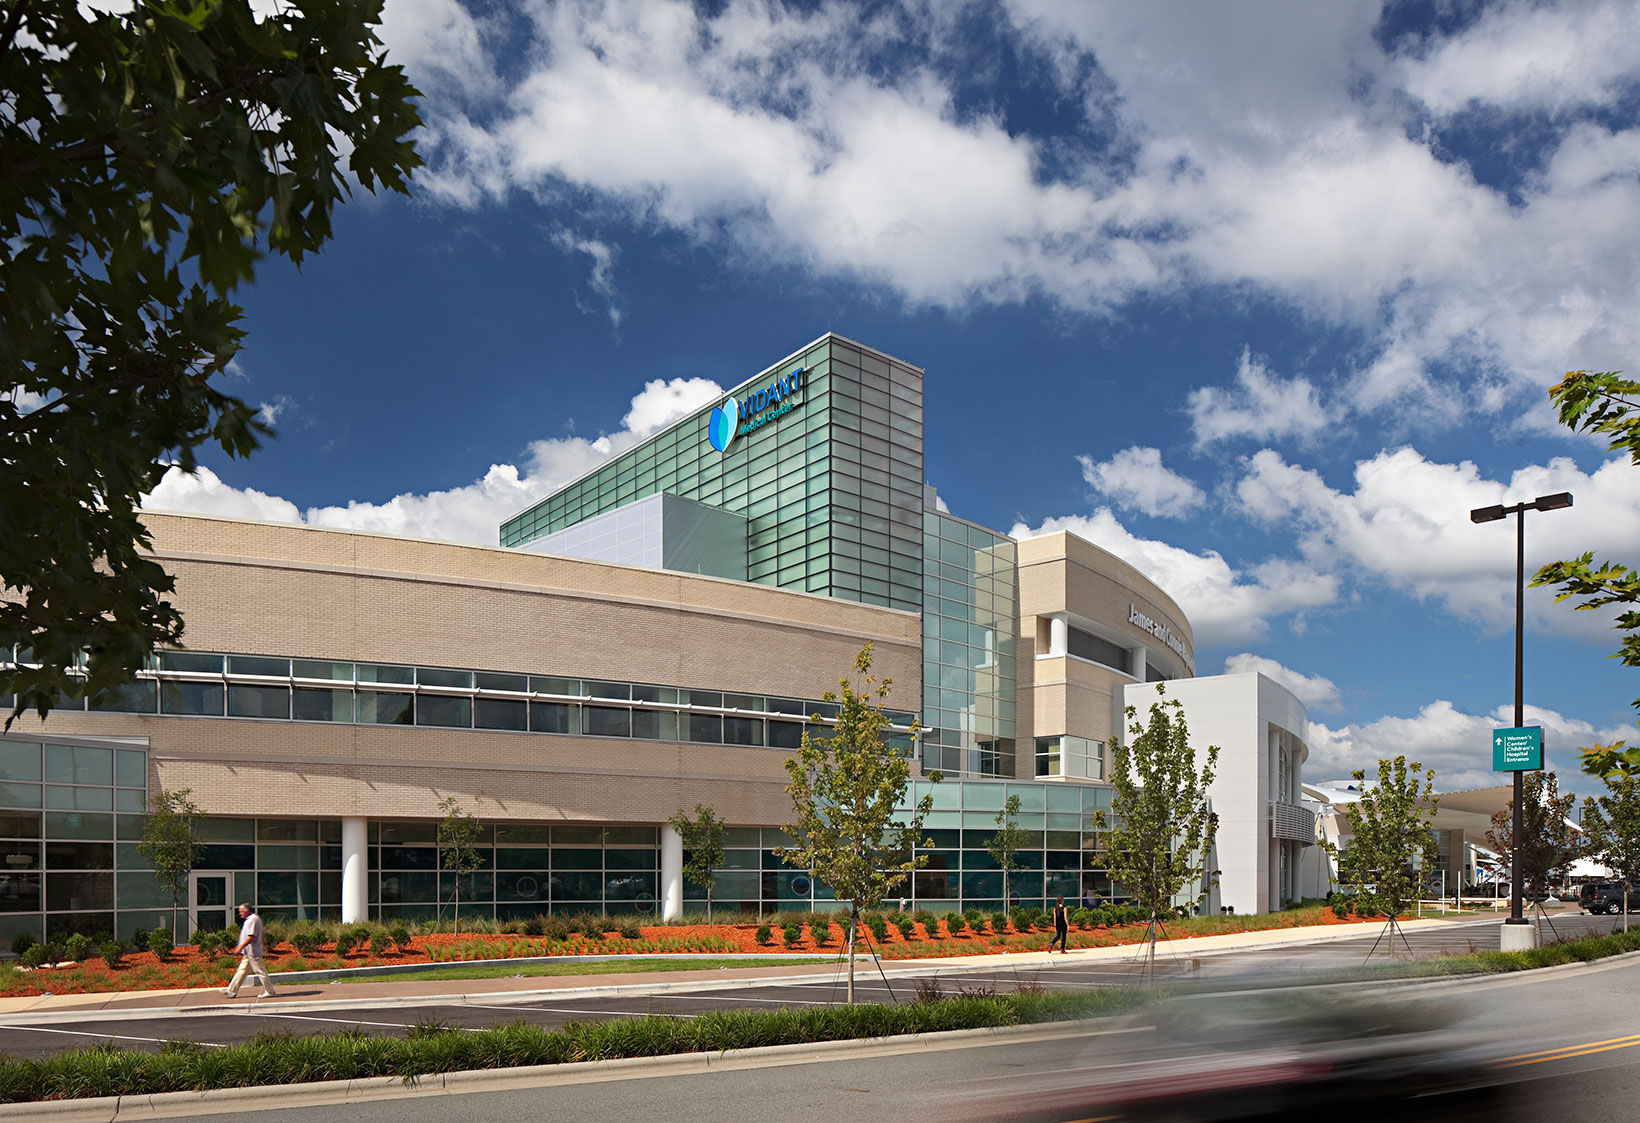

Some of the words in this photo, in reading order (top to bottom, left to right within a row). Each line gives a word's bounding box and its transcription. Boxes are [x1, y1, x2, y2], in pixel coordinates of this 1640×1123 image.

[739, 367, 803, 420] VIDANT
[740, 414, 767, 435] Medical
[767, 402, 794, 421] Center
[1128, 603, 1153, 635] James
[1153, 623, 1166, 642] and
